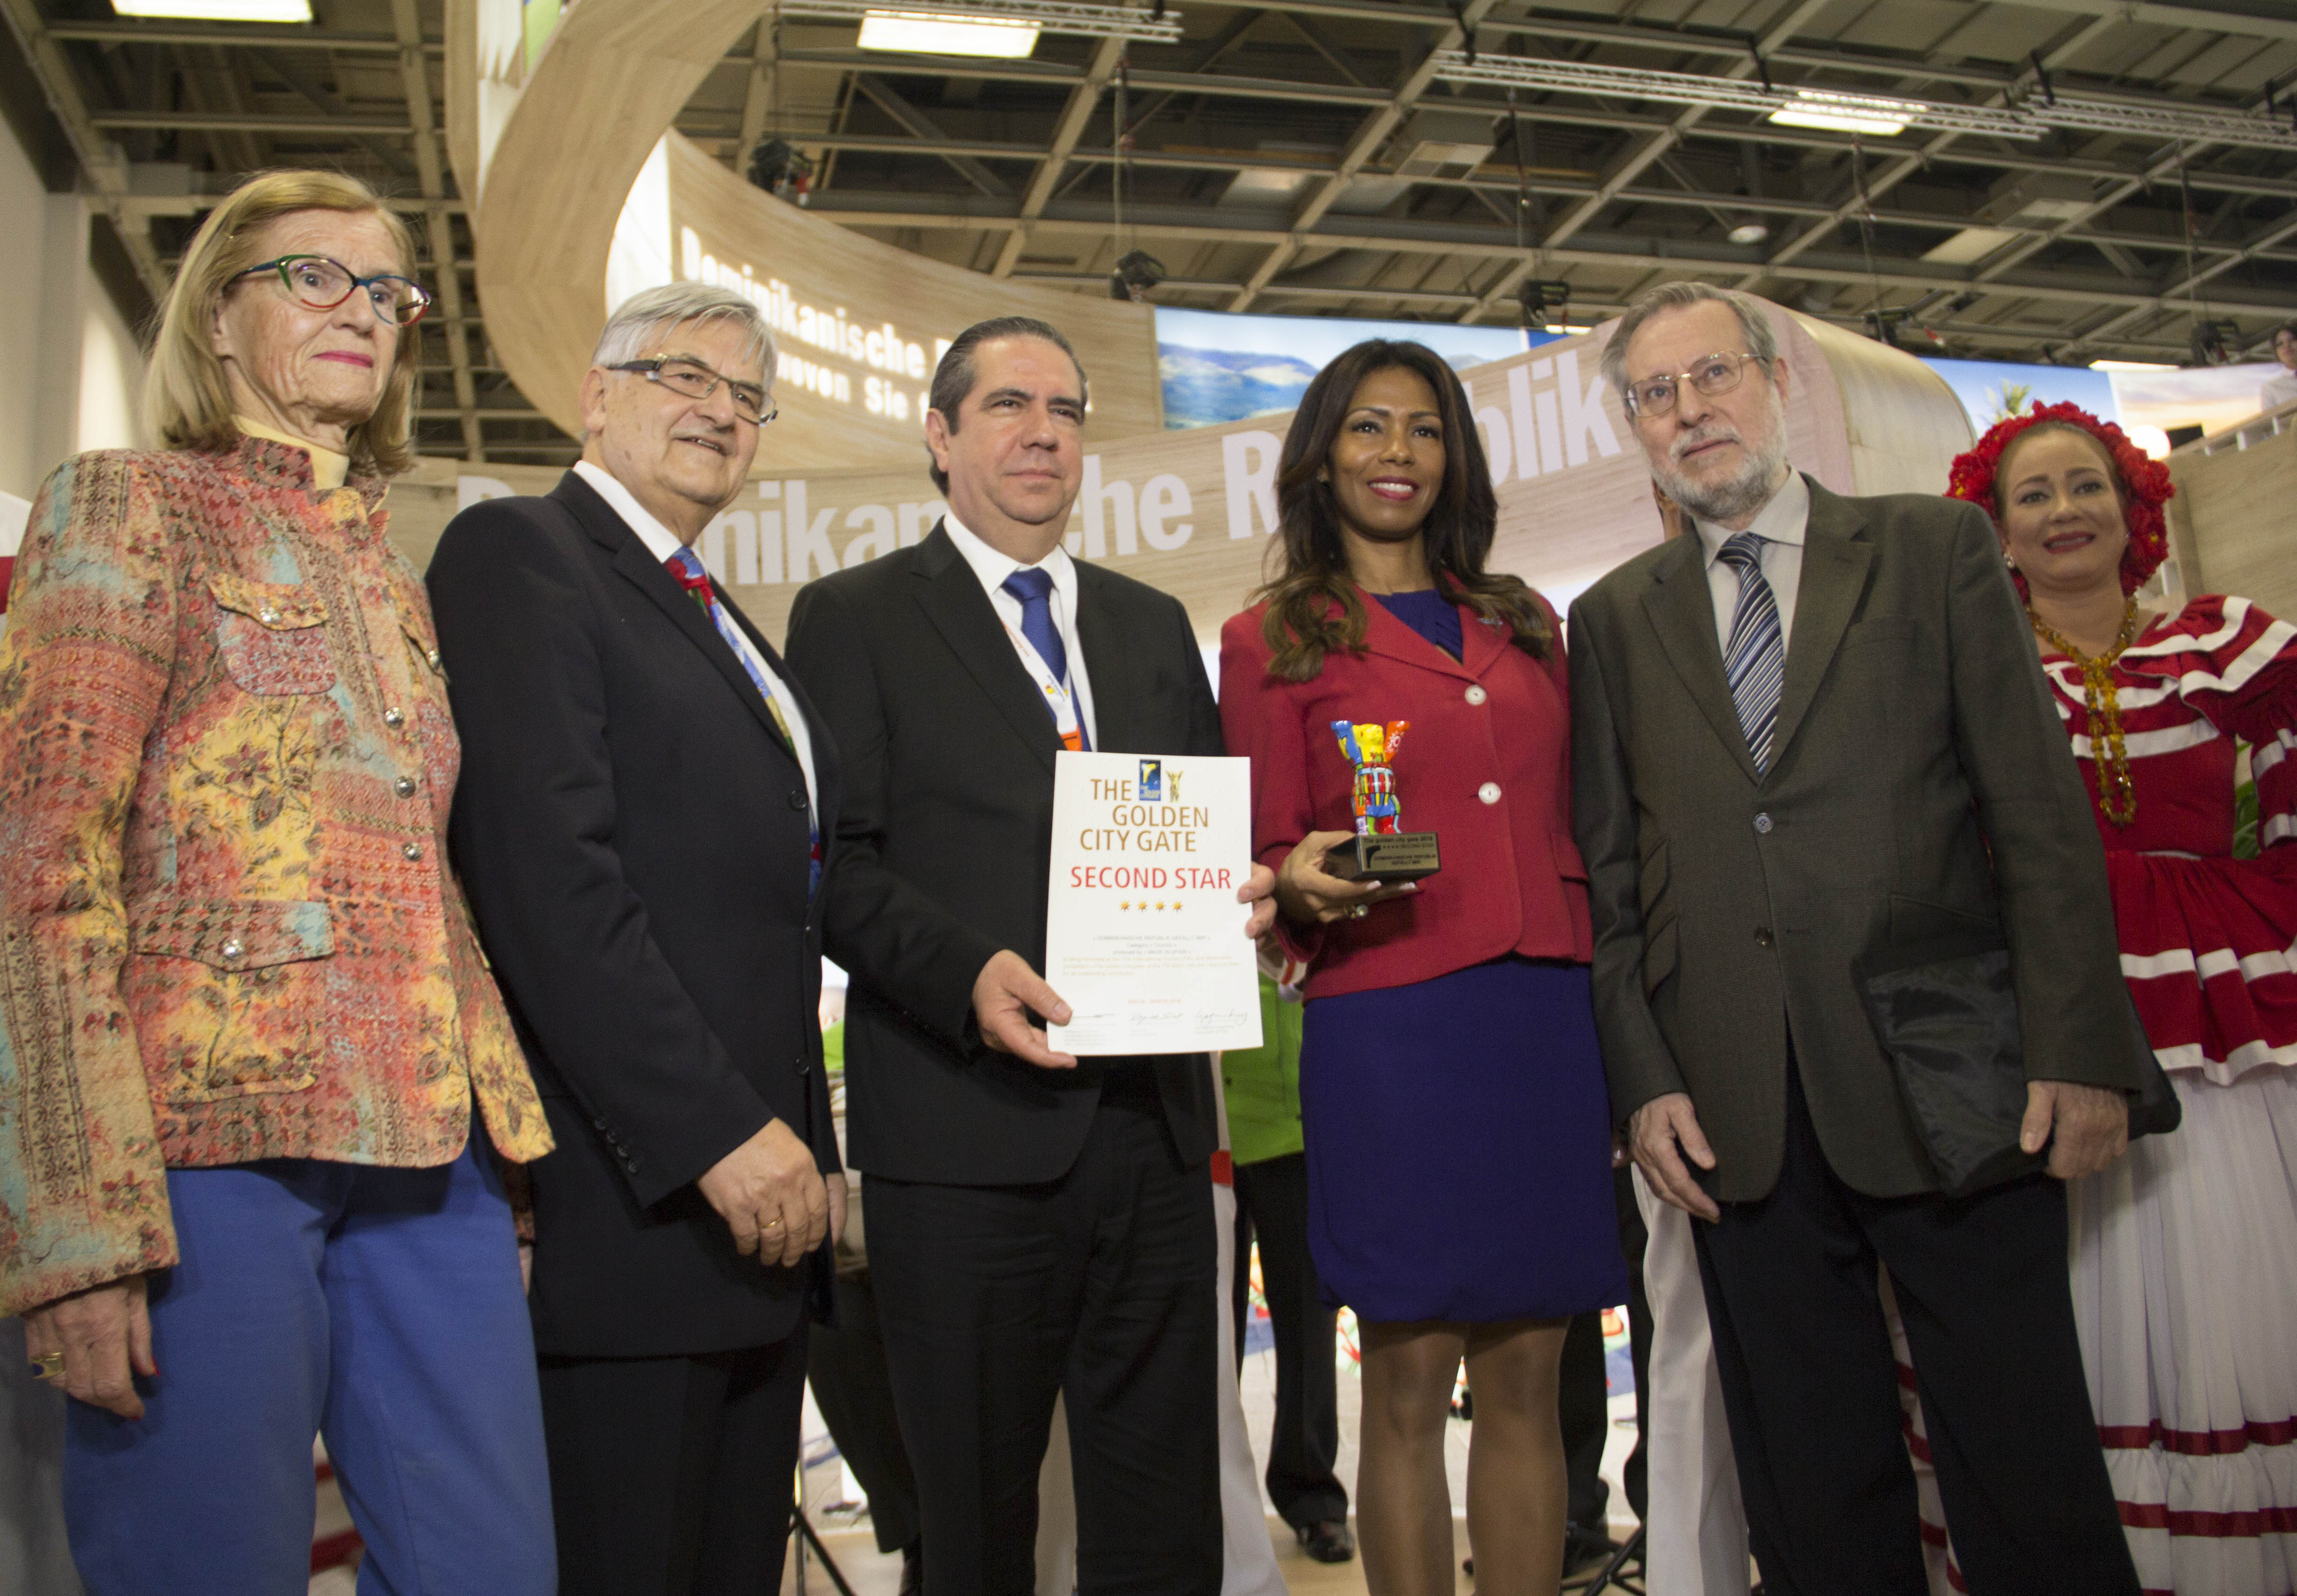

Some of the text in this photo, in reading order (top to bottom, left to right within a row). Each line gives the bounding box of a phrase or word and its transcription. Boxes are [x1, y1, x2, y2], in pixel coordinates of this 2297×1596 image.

[864, 376, 909, 420] Sie
[1221, 349, 1621, 541] Rblik
[1090, 779, 1131, 801] THE
[1113, 805, 1208, 828] GOLDEN
[1080, 829, 1196, 852] CITY GATE
[1070, 866, 1231, 889] SECOND STAR
